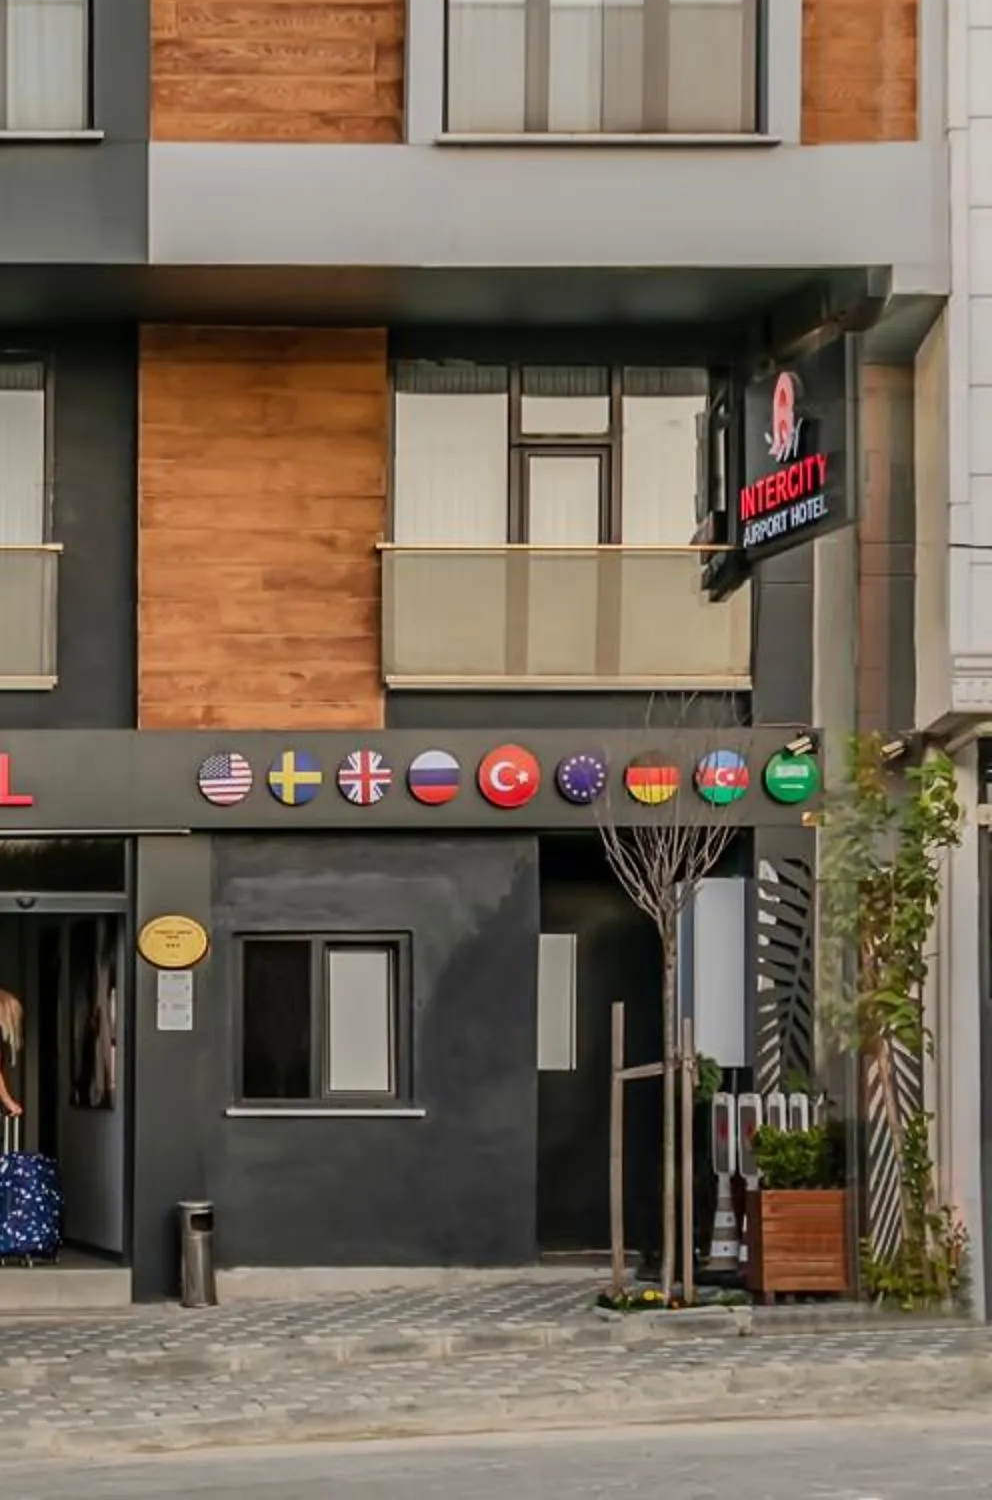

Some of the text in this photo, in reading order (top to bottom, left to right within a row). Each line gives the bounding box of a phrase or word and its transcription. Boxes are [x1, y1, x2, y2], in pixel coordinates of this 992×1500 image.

[740, 453, 828, 519] INTERCITY
[743, 494, 828, 548] AIRPORT HOTEL
